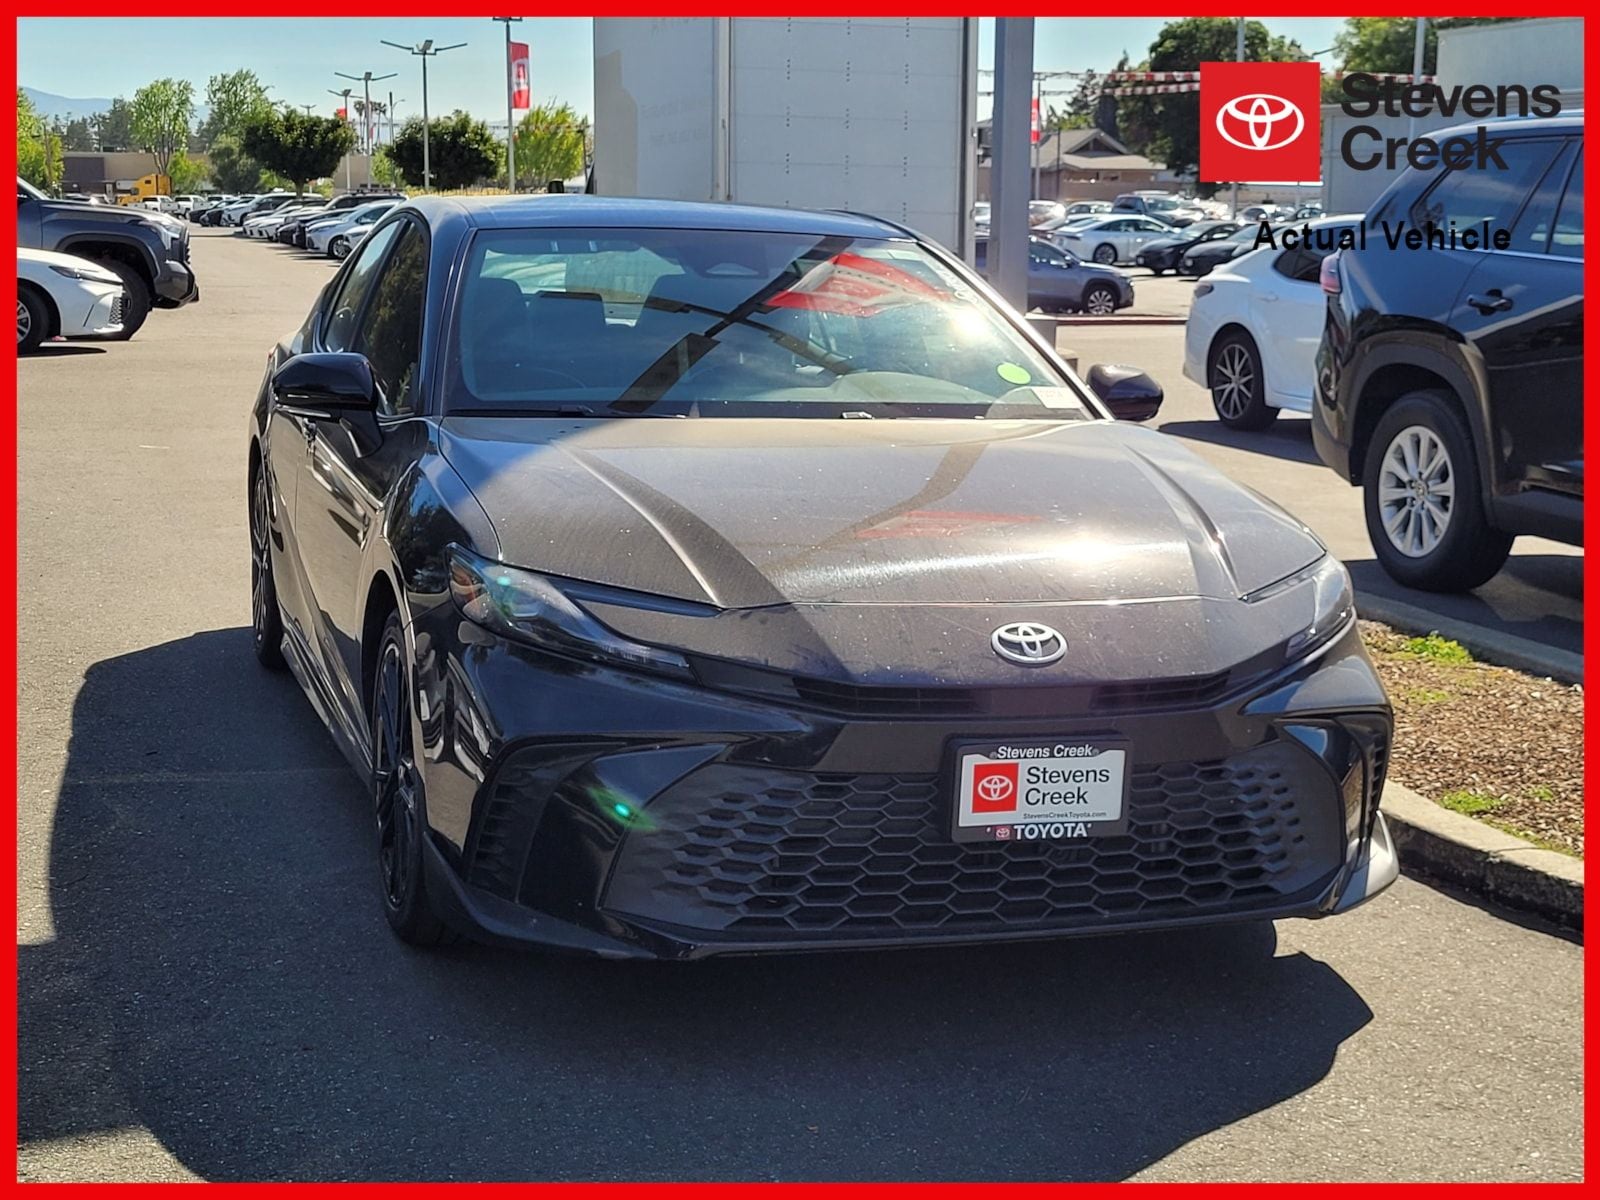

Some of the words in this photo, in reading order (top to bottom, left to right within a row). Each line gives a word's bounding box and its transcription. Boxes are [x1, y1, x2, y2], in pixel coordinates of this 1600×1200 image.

[997, 745, 1051, 759] Stevens
[1053, 743, 1093, 758] Creek
[1026, 766, 1110, 785] Stevens
[1025, 786, 1088, 806] Creek
[1023, 811, 1107, 820] StevensCreekToyota.com
[1013, 822, 1088, 840] TOYOTA
